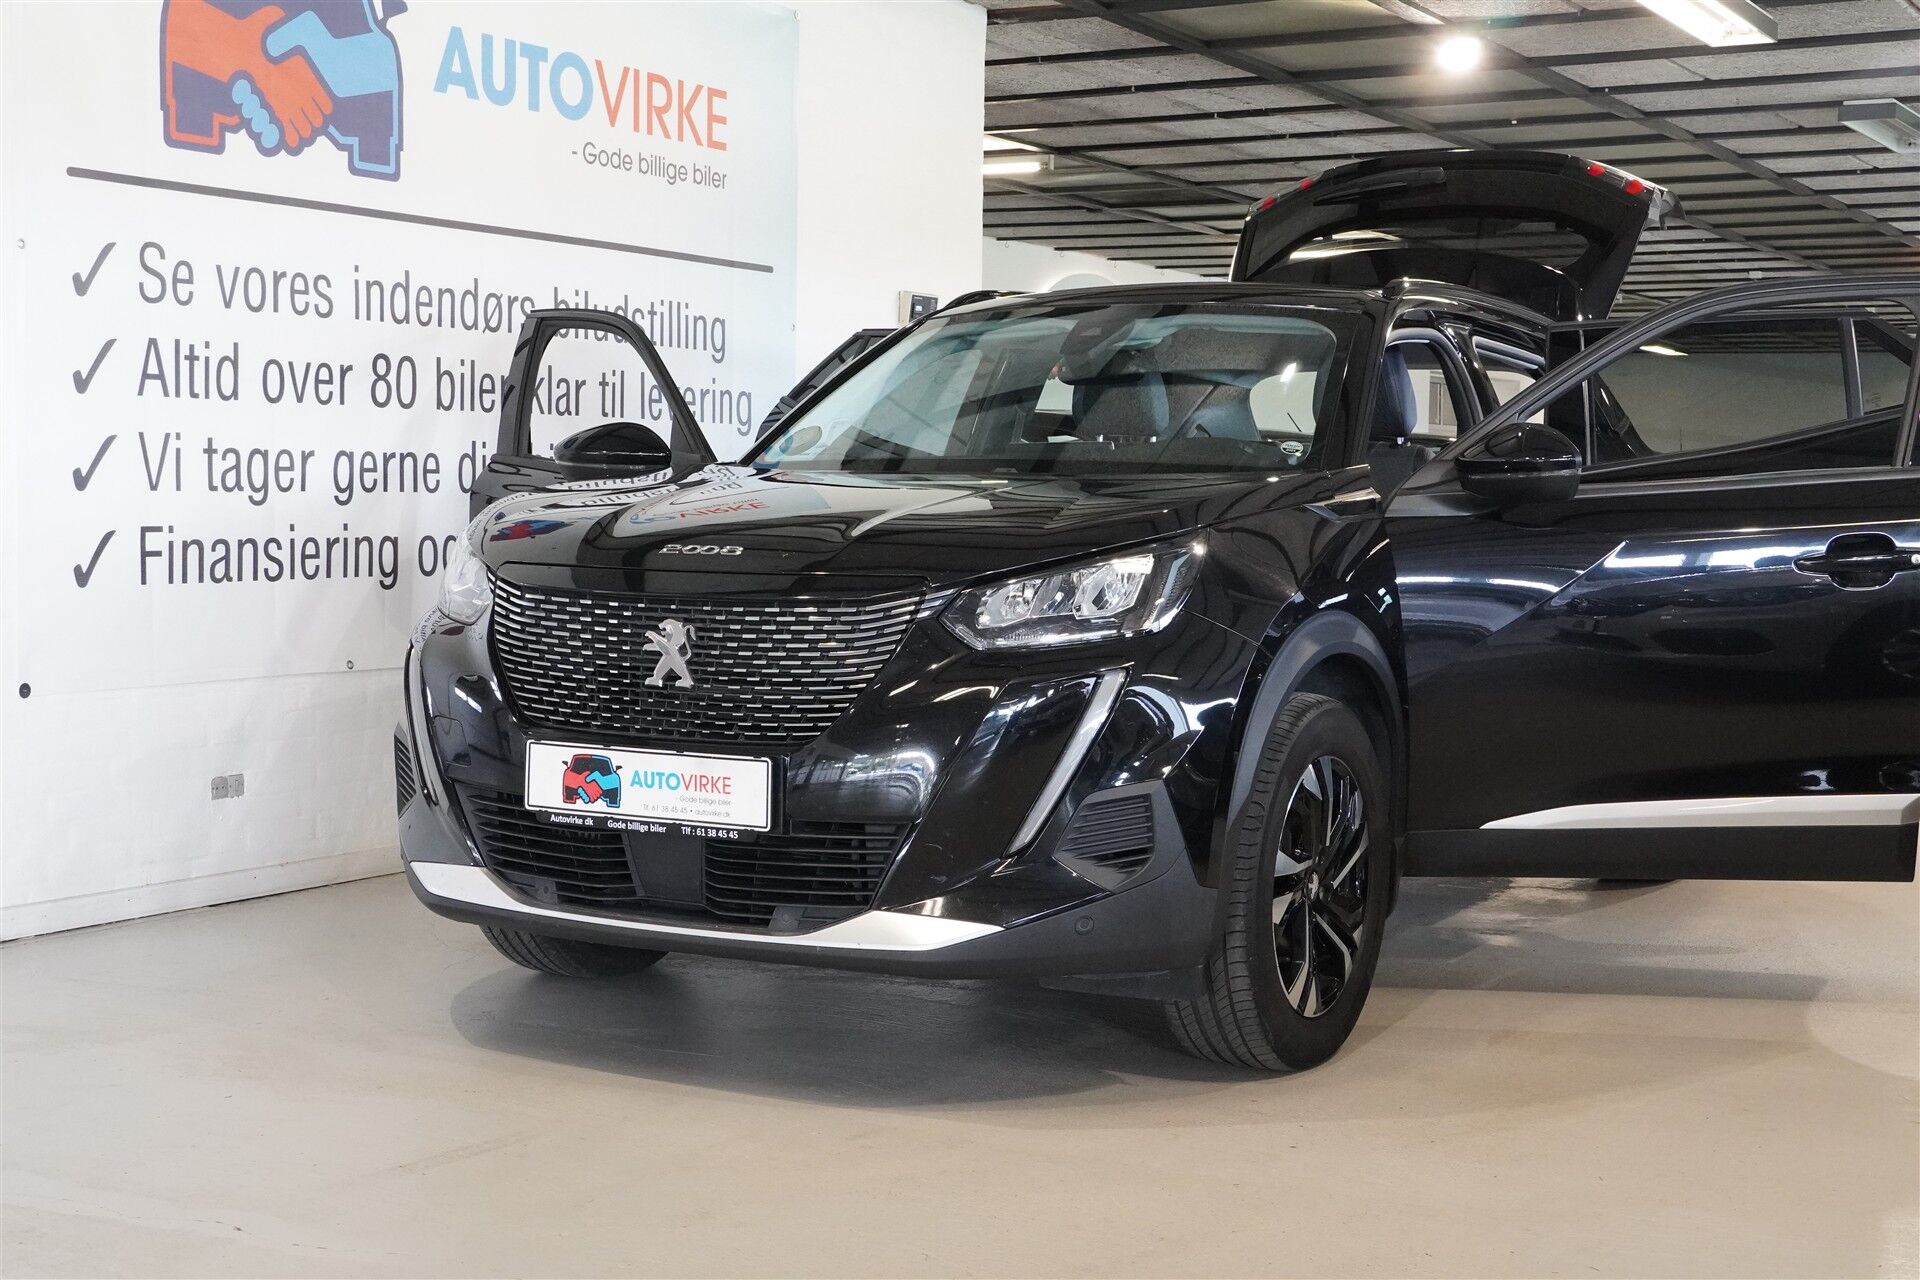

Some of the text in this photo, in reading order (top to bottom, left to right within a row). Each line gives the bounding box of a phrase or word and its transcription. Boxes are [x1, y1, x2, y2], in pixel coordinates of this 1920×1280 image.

[434, 26, 728, 151] AUTOVIRKE
[583, 142, 633, 172] Gode
[639, 152, 688, 185] billige
[693, 163, 727, 189] biler
[139, 241, 194, 307] Se
[216, 261, 334, 319] vores
[138, 337, 239, 401] Altid
[262, 359, 353, 405] over
[371, 353, 417, 409] 80
[599, 369, 625, 418] til
[640, 372, 752, 437] leering
[138, 432, 182, 491] Vi
[203, 437, 315, 506] tager
[333, 450, 441, 506] gerne
[140, 523, 400, 591] Finansiering
[659, 544, 744, 556] 2008
[630, 769, 732, 795] AUTOVIRKE
[607, 820, 667, 833] Gode billige biler
[696, 827, 706, 836] 61
[707, 829, 717, 838] 38
[717, 830, 727, 838] 45
[728, 830, 738, 839] 45
